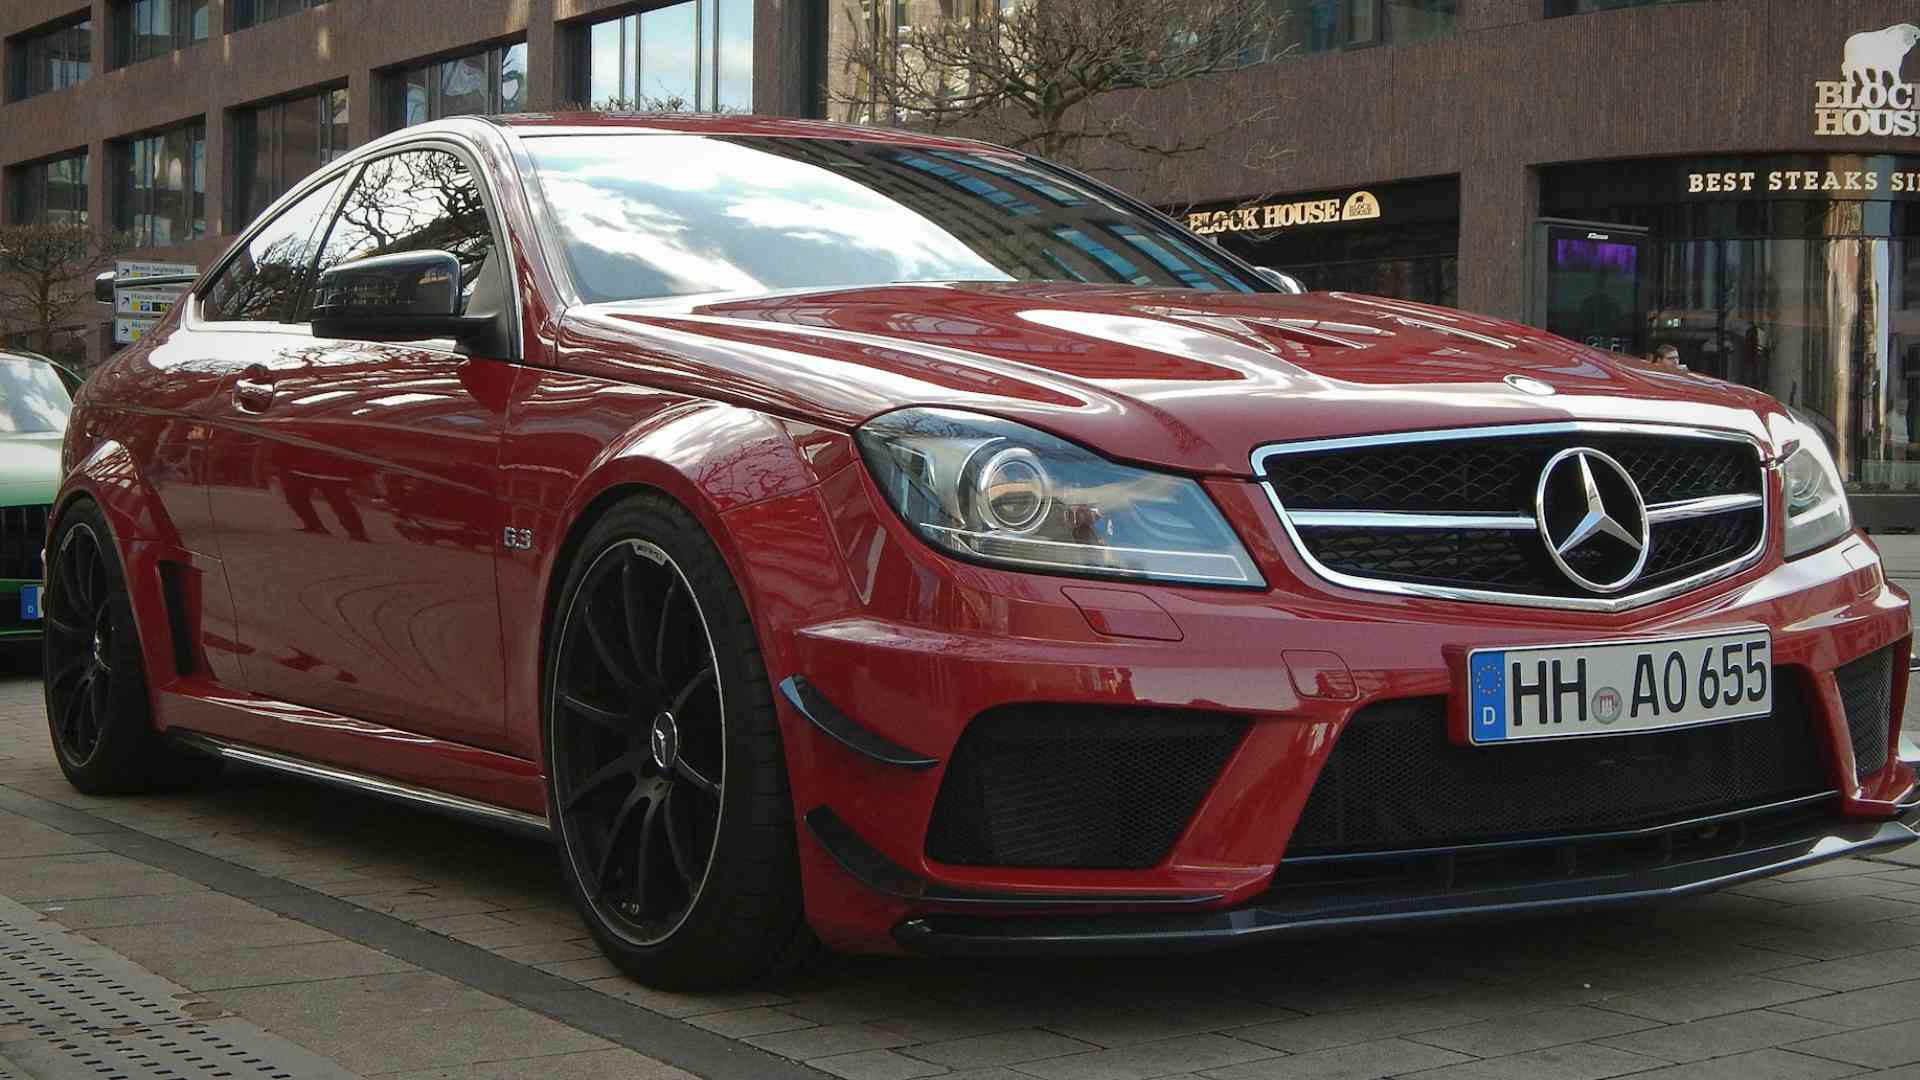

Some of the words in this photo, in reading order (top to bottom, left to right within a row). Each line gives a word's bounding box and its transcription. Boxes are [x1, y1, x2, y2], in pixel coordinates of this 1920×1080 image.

[1814, 109, 1920, 136] HOUS
[1688, 172, 1755, 193] BEST
[1768, 171, 1878, 191] STEAKS
[1890, 172, 1920, 193] SI
[1187, 207, 1260, 234] BLOCK
[1263, 199, 1341, 228] HOUSE
[1512, 658, 1587, 726] HH
[1630, 651, 1687, 718] AO
[1699, 641, 1767, 709] 655
[1482, 707, 1496, 726] D
